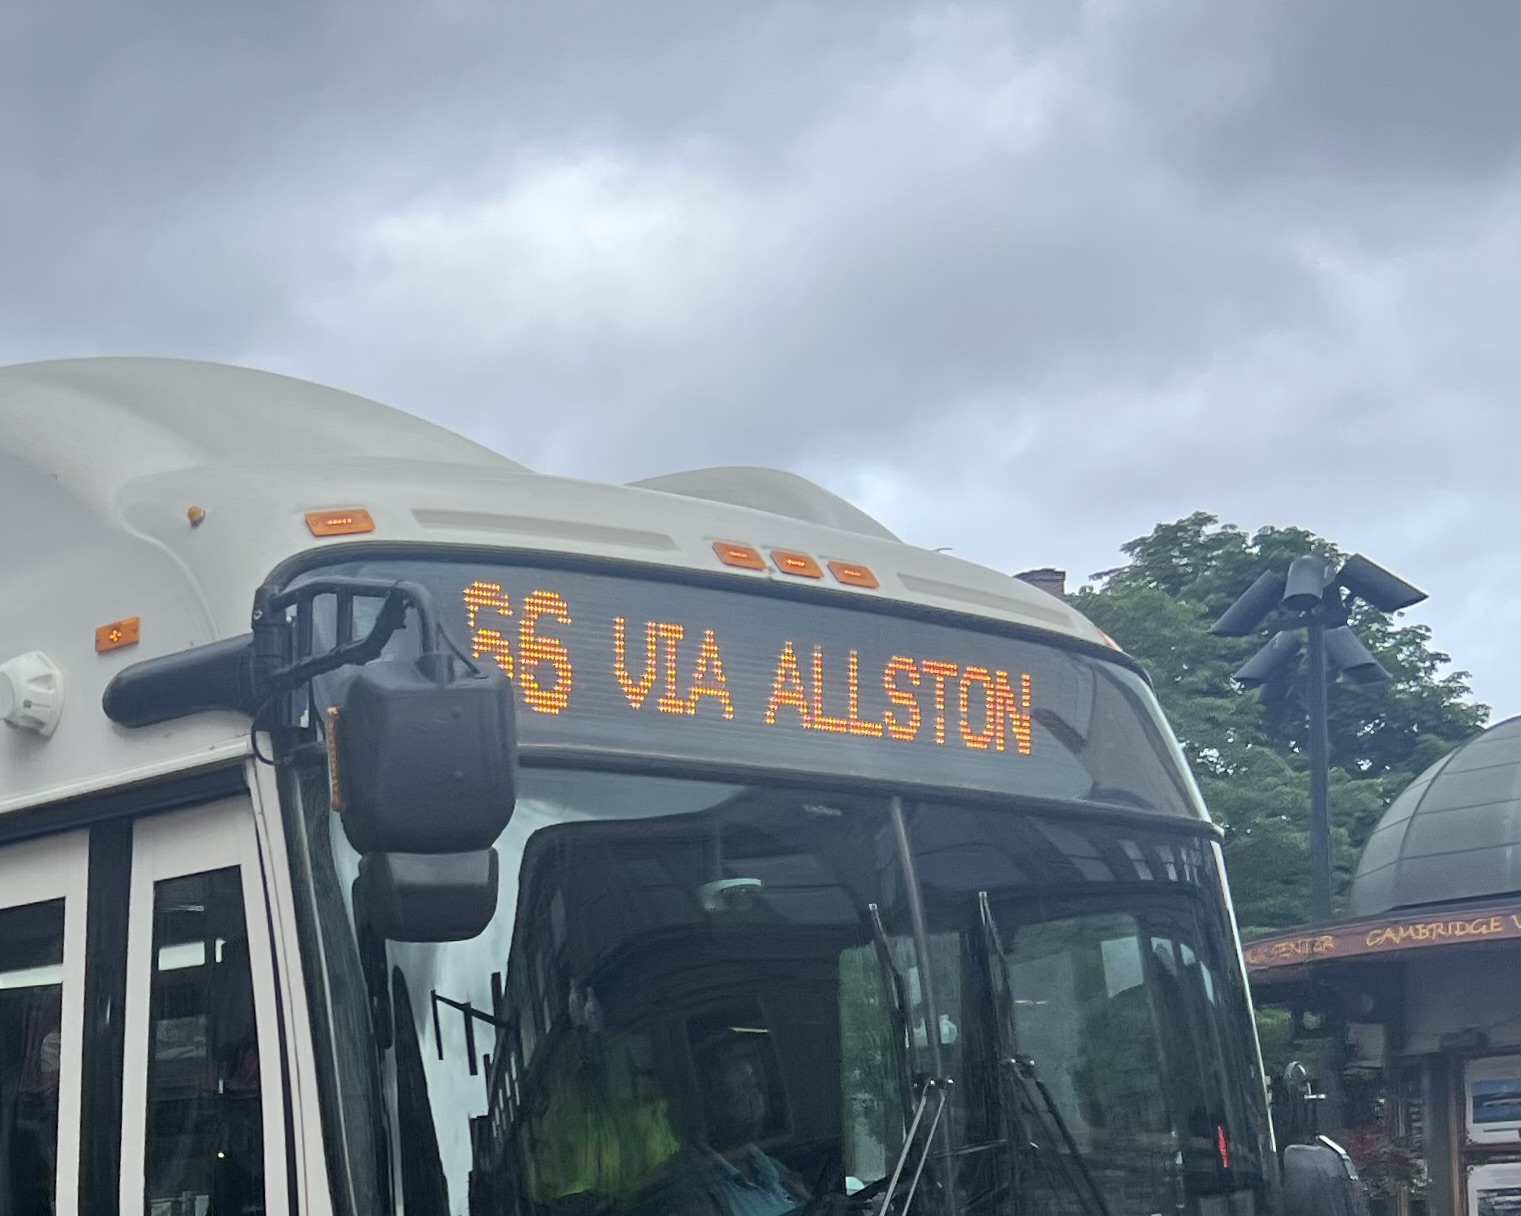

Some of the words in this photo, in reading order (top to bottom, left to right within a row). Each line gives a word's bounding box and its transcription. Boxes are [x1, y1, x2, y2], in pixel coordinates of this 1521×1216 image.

[463, 581, 572, 714] 66
[614, 616, 734, 719] VIA
[765, 641, 1031, 754] ALLSTON
[1366, 916, 1503, 947] CAMBRIDGE
